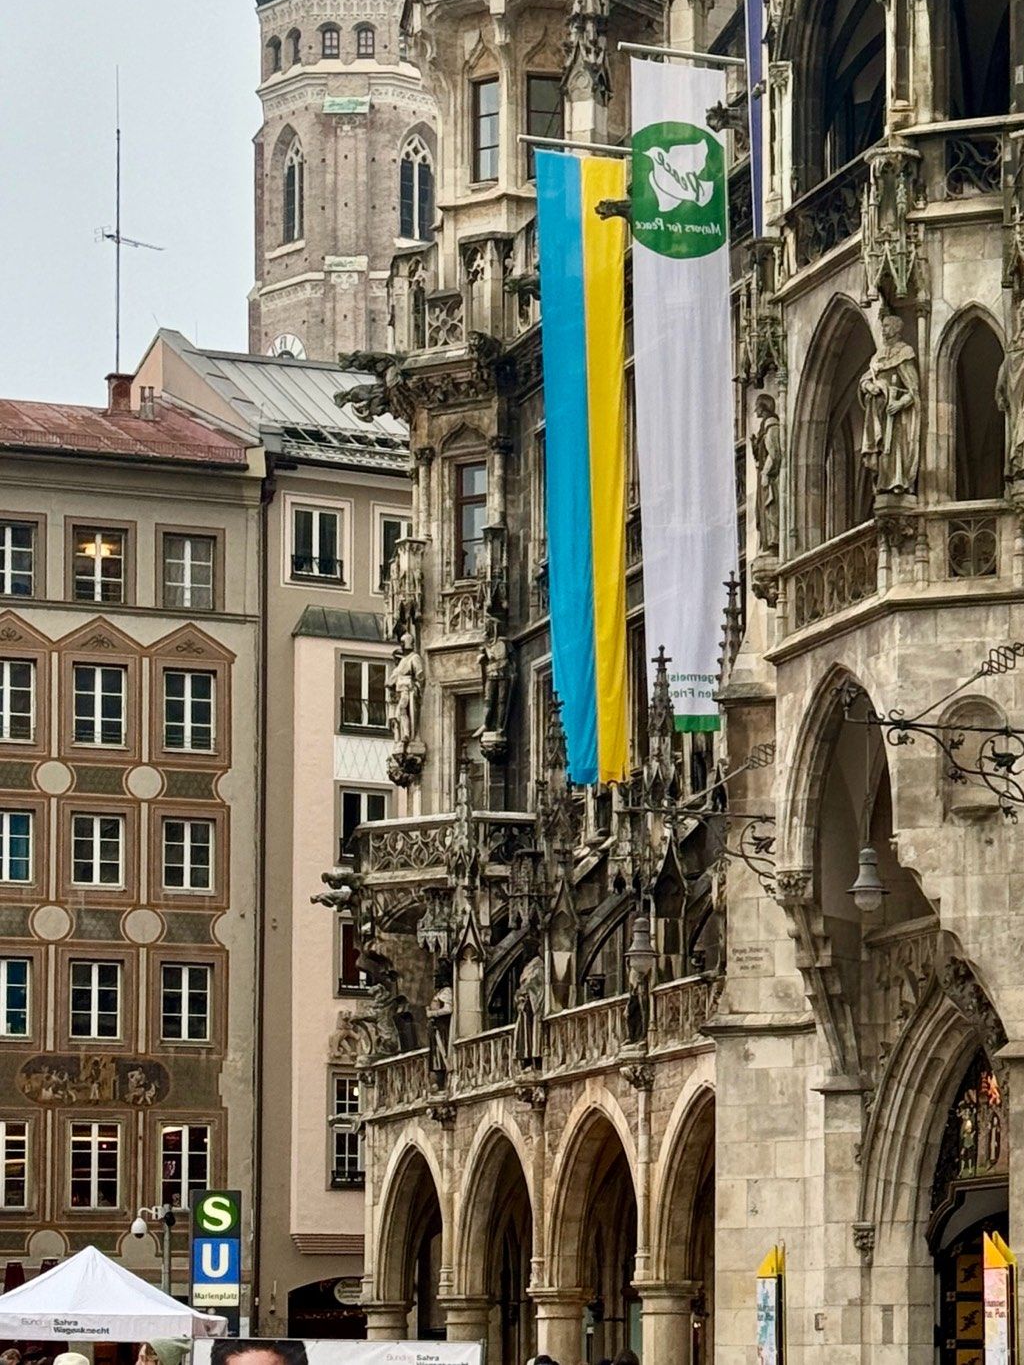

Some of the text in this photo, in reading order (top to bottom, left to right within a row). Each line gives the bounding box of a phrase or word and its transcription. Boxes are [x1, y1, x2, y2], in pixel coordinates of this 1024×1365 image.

[202, 1196, 232, 1232] S
[202, 1243, 229, 1279] U
[195, 1292, 237, 1301] Marienplatz
